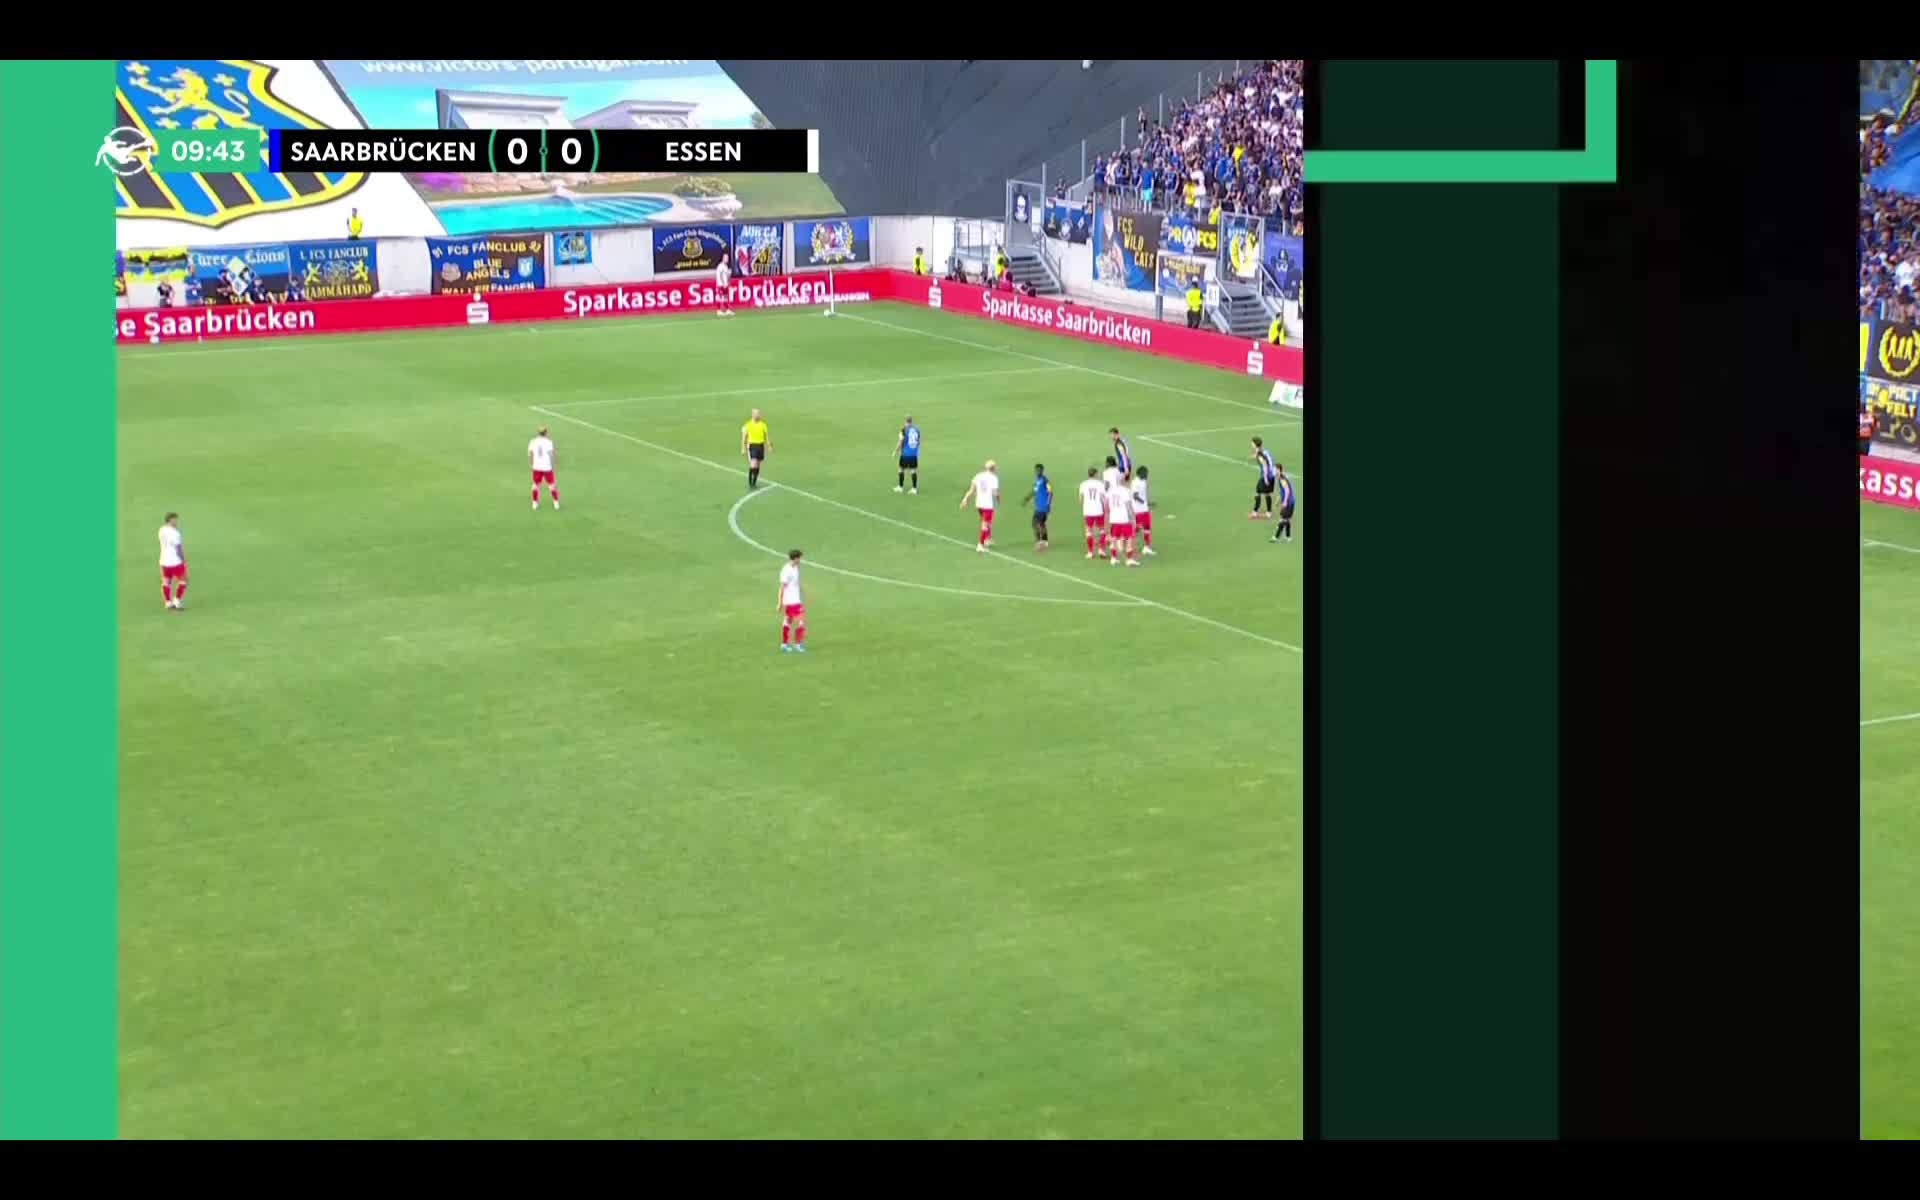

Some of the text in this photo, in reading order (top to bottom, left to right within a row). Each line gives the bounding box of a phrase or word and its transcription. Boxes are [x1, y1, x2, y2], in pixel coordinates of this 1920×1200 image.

[447, 239, 528, 256] FCS FANCLUB
[465, 268, 511, 282] ANGELS
[473, 257, 503, 270] BLUE
[563, 287, 683, 317] Sparkasse
[143, 305, 316, 337] Saarbrücken
[982, 290, 1152, 347] Sparkasse Saarbrücken
